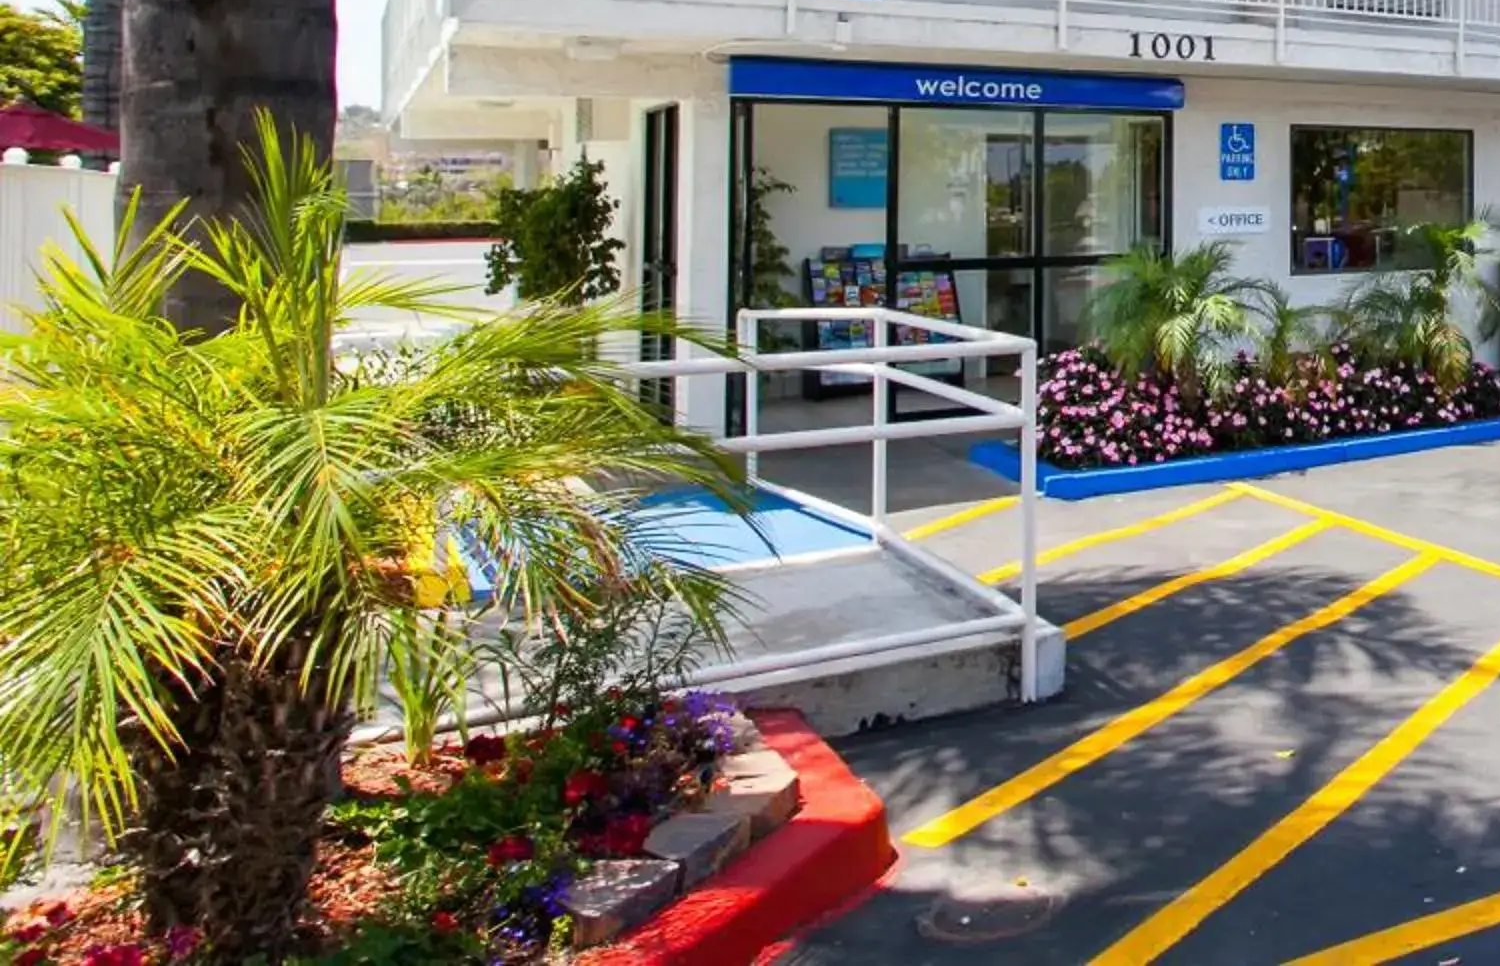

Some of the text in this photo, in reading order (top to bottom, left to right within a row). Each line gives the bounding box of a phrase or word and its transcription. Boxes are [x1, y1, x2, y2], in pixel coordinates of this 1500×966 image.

[1129, 33, 1216, 60] 1001
[915, 75, 1043, 100] welcome
[1219, 213, 1263, 227] OFFICE
